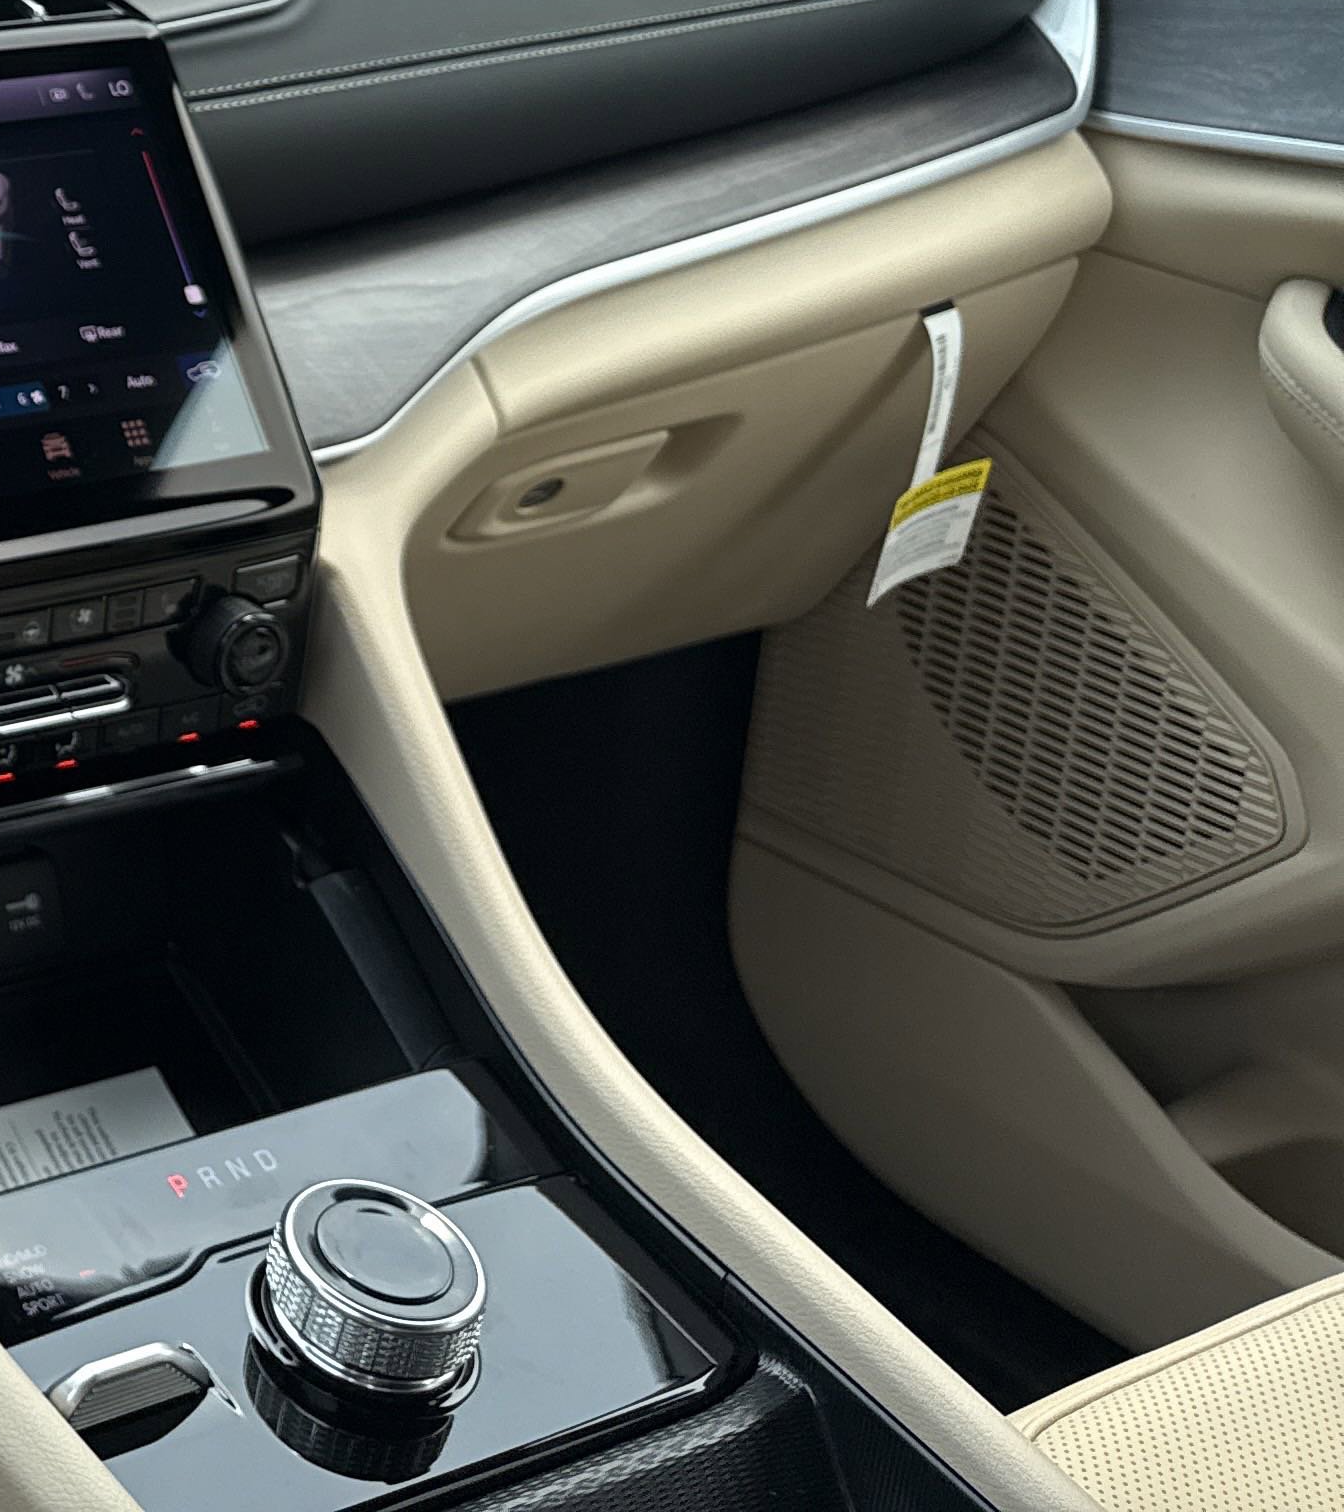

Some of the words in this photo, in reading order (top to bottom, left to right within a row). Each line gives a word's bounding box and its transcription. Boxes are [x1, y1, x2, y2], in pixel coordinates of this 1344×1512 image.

[108, 79, 132, 97] LO
[97, 324, 125, 339] Rear
[126, 374, 157, 389] Auto
[17, 391, 30, 406] 6
[166, 1172, 190, 1200] P
[196, 1164, 219, 1190] R
[226, 1156, 252, 1181] N
[257, 1148, 279, 1173] D
[16, 1278, 54, 1299] AUTO
[22, 1291, 65, 1317] SPORT
